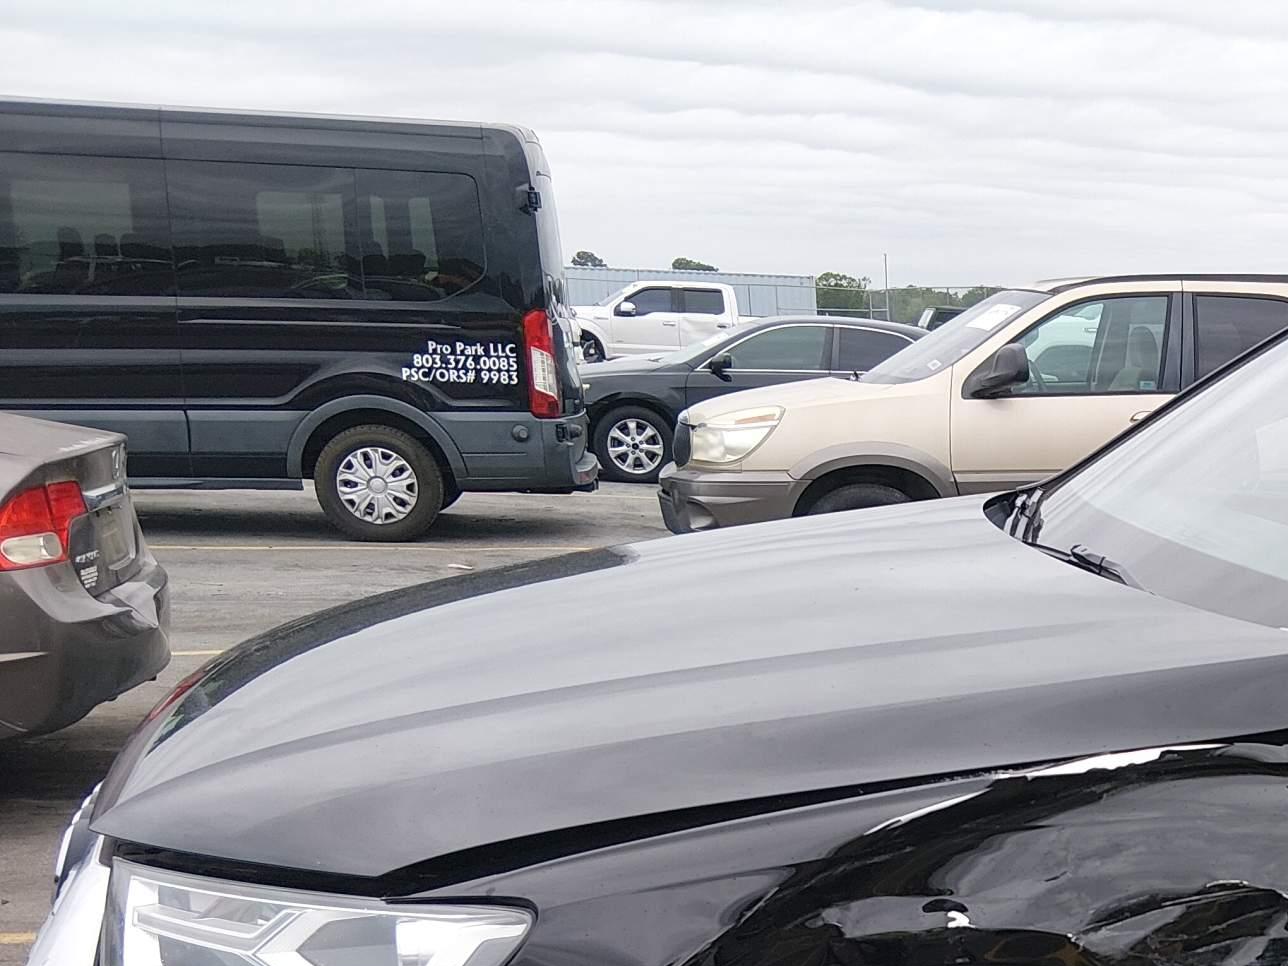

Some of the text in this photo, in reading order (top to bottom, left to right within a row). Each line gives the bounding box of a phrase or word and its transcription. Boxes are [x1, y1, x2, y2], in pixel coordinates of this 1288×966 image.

[428, 340, 516, 357] Pro Park LLC
[413, 354, 518, 370] 803.376.0085
[401, 367, 519, 385] PSC/ORS# 9983
